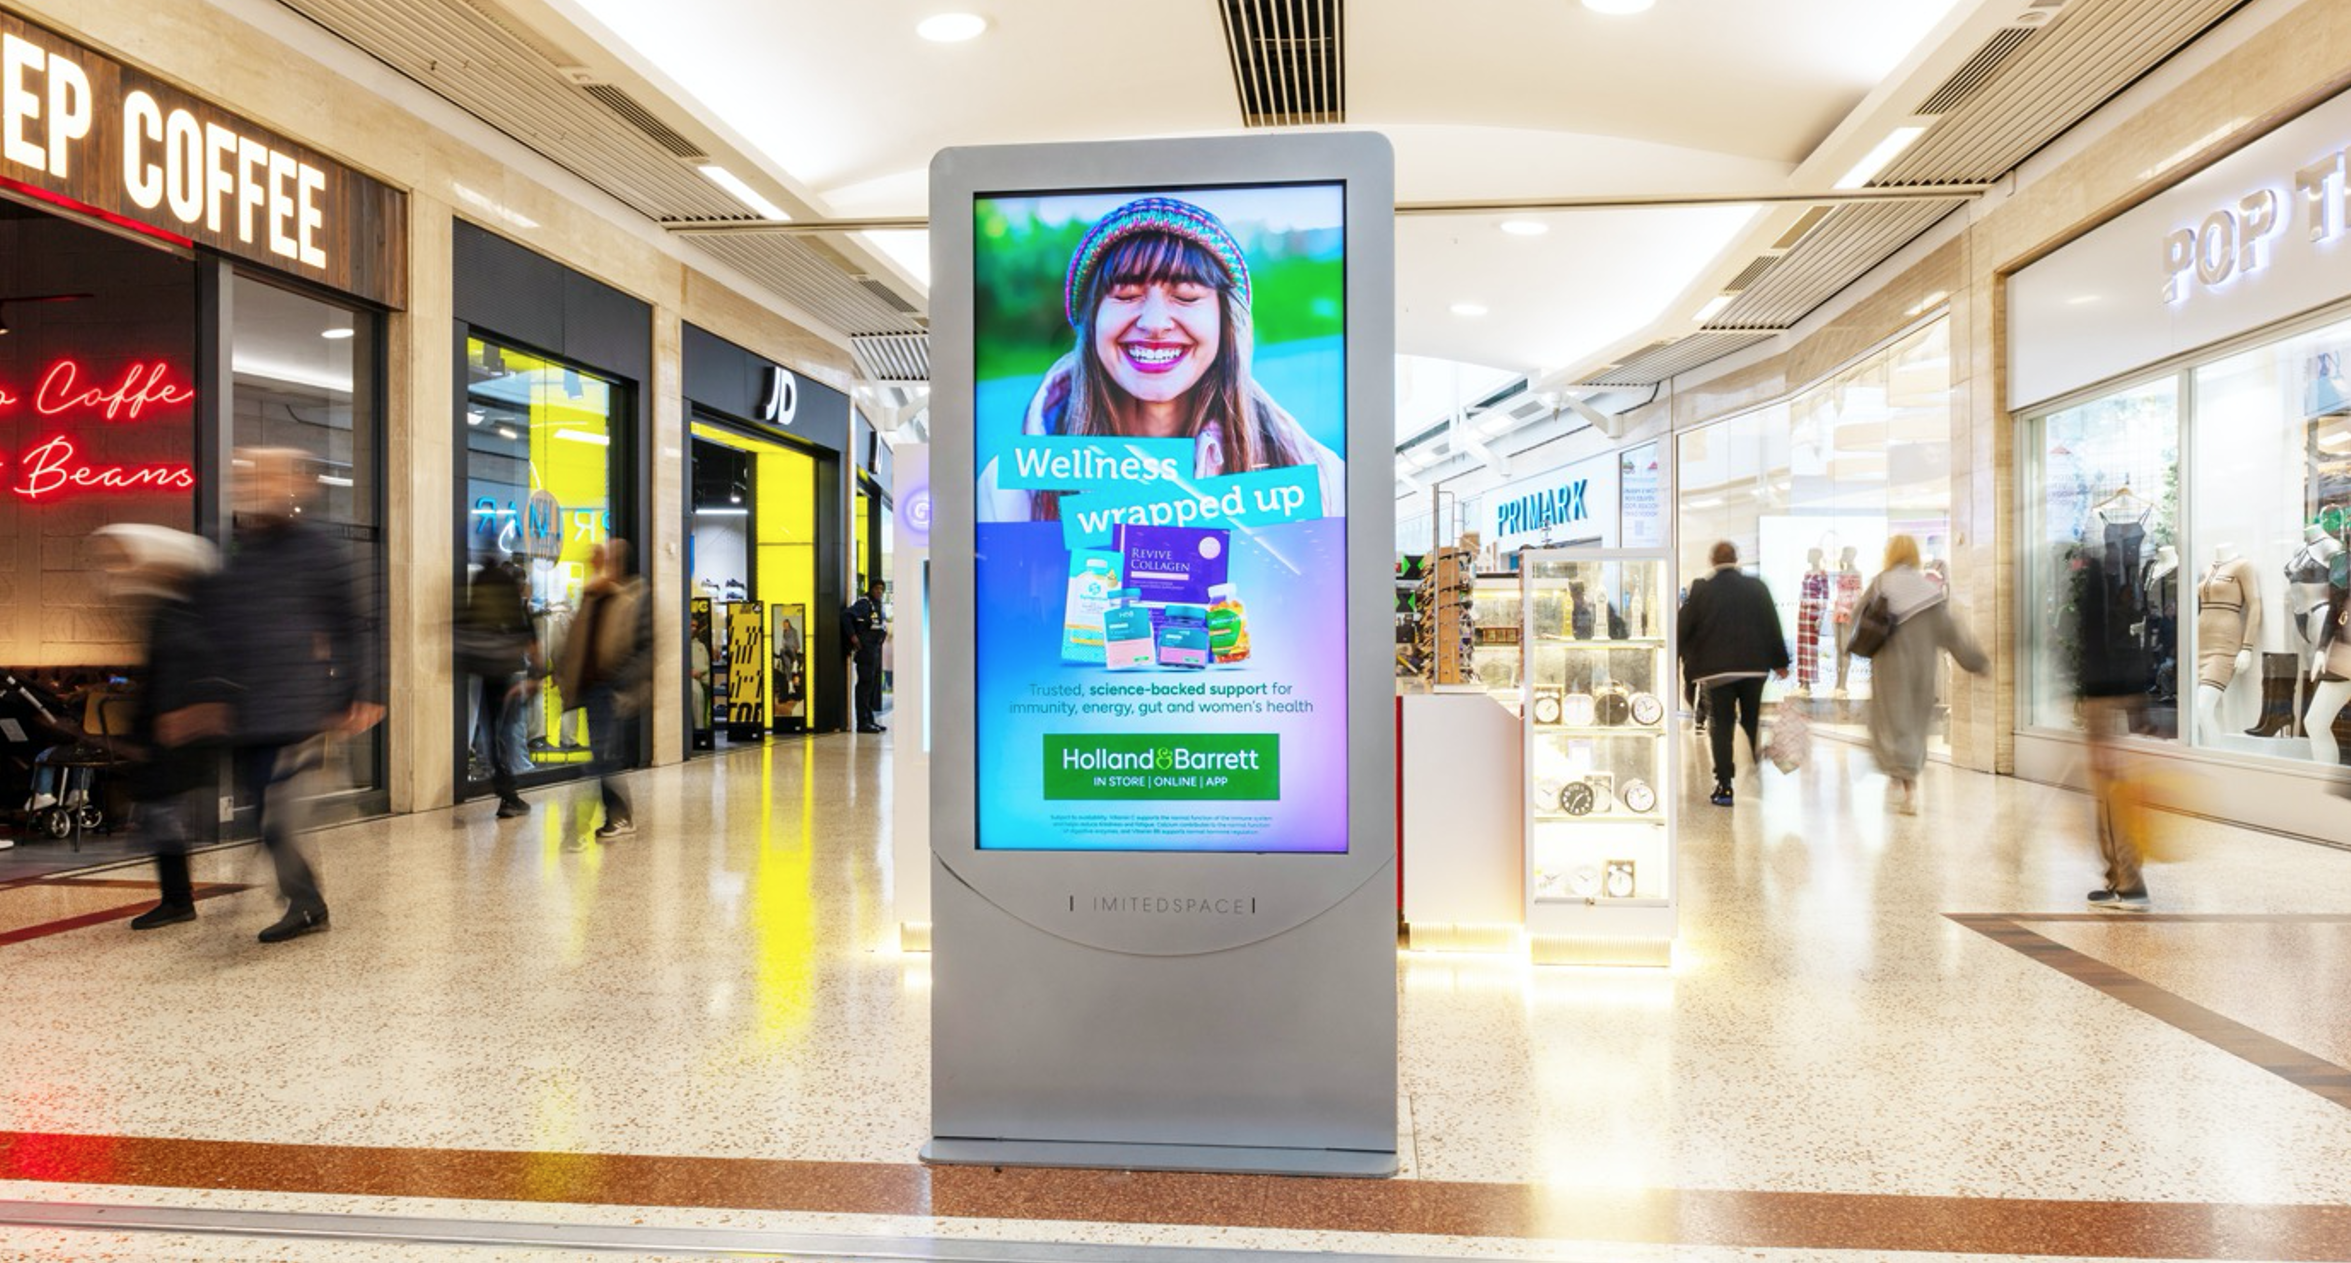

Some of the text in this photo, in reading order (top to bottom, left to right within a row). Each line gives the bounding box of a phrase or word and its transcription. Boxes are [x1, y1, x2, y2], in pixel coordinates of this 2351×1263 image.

[2, 32, 327, 270] EP COFFEE
[2162, 145, 2351, 304] POP T
[37, 361, 194, 419] Coffe
[764, 366, 798, 426] JD
[13, 435, 194, 498] Beans
[1014, 447, 1178, 480] Wellness
[1077, 484, 1306, 535] wrapped up
[1498, 478, 1588, 538] PRIMARK
[1130, 559, 1191, 572] COLLAGEN
[1131, 547, 1173, 560] REVIVE
[1009, 701, 1314, 717] immunity, energy, gut and women's health
[1029, 682, 1293, 699] Trusted, science-backed support for
[1094, 776, 1106, 787] IN
[1108, 776, 1146, 787] STORE
[1153, 776, 1198, 787] ONLINE
[1206, 776, 1229, 788] APP
[1093, 896, 1244, 914] IMITEDSPACE
